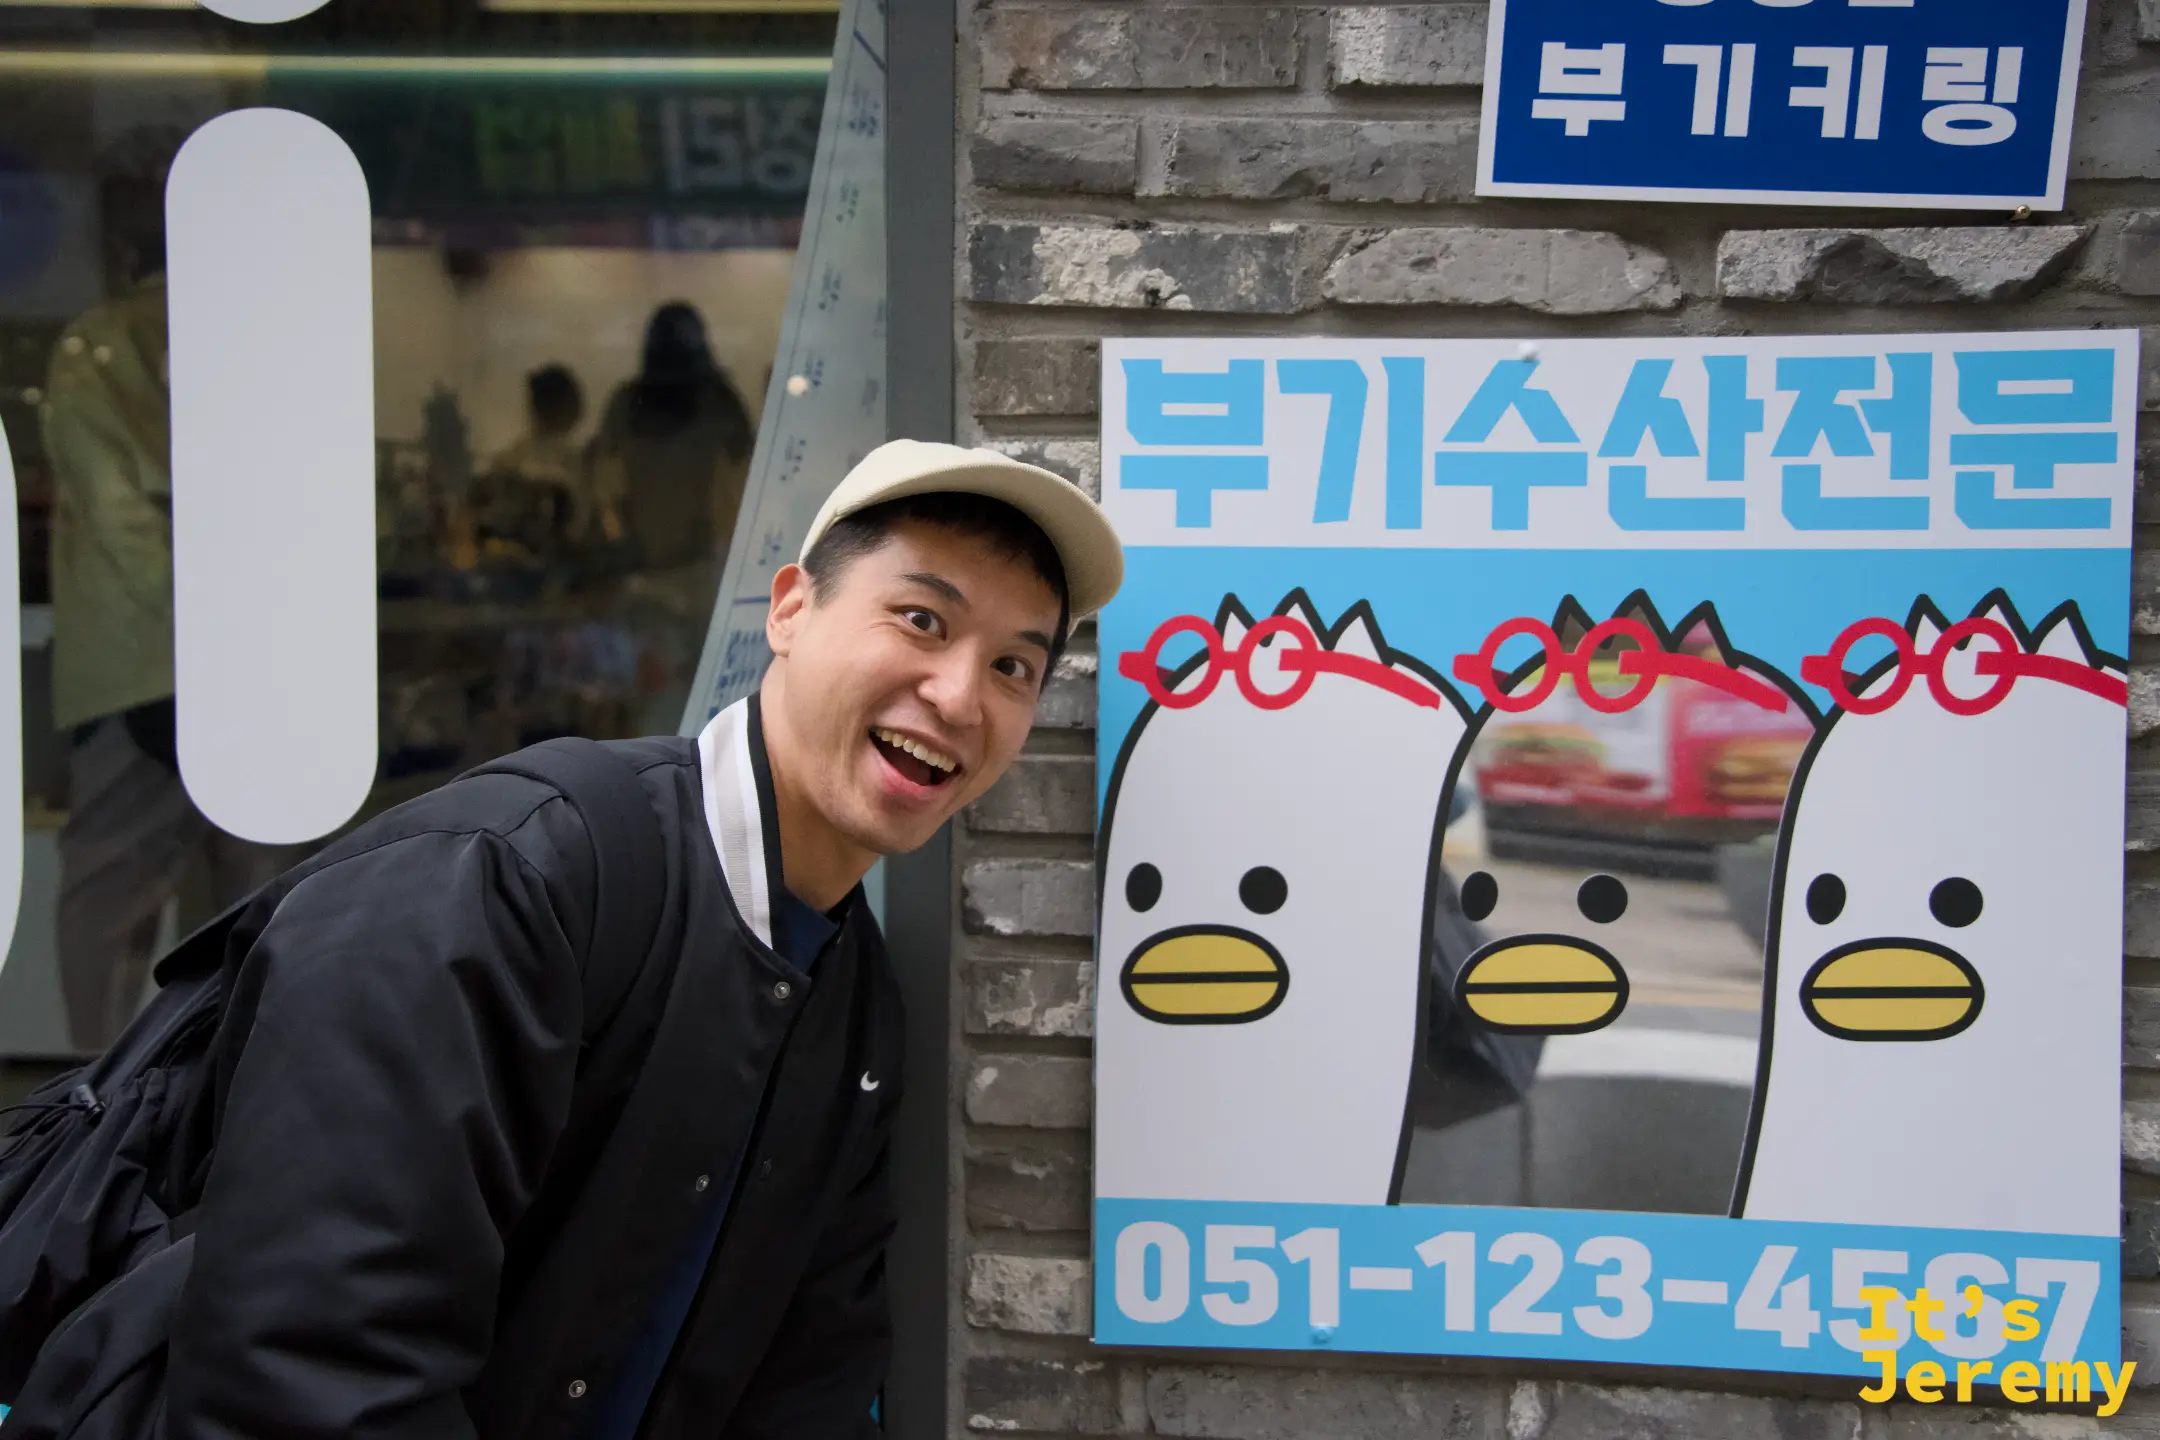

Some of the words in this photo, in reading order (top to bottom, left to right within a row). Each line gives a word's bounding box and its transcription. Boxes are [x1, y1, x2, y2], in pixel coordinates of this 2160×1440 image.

[1532, 42, 2022, 145] 부기키링
[1120, 348, 2118, 531] 부기수산전문
[1115, 1221, 2101, 1363] 051-123-4567
